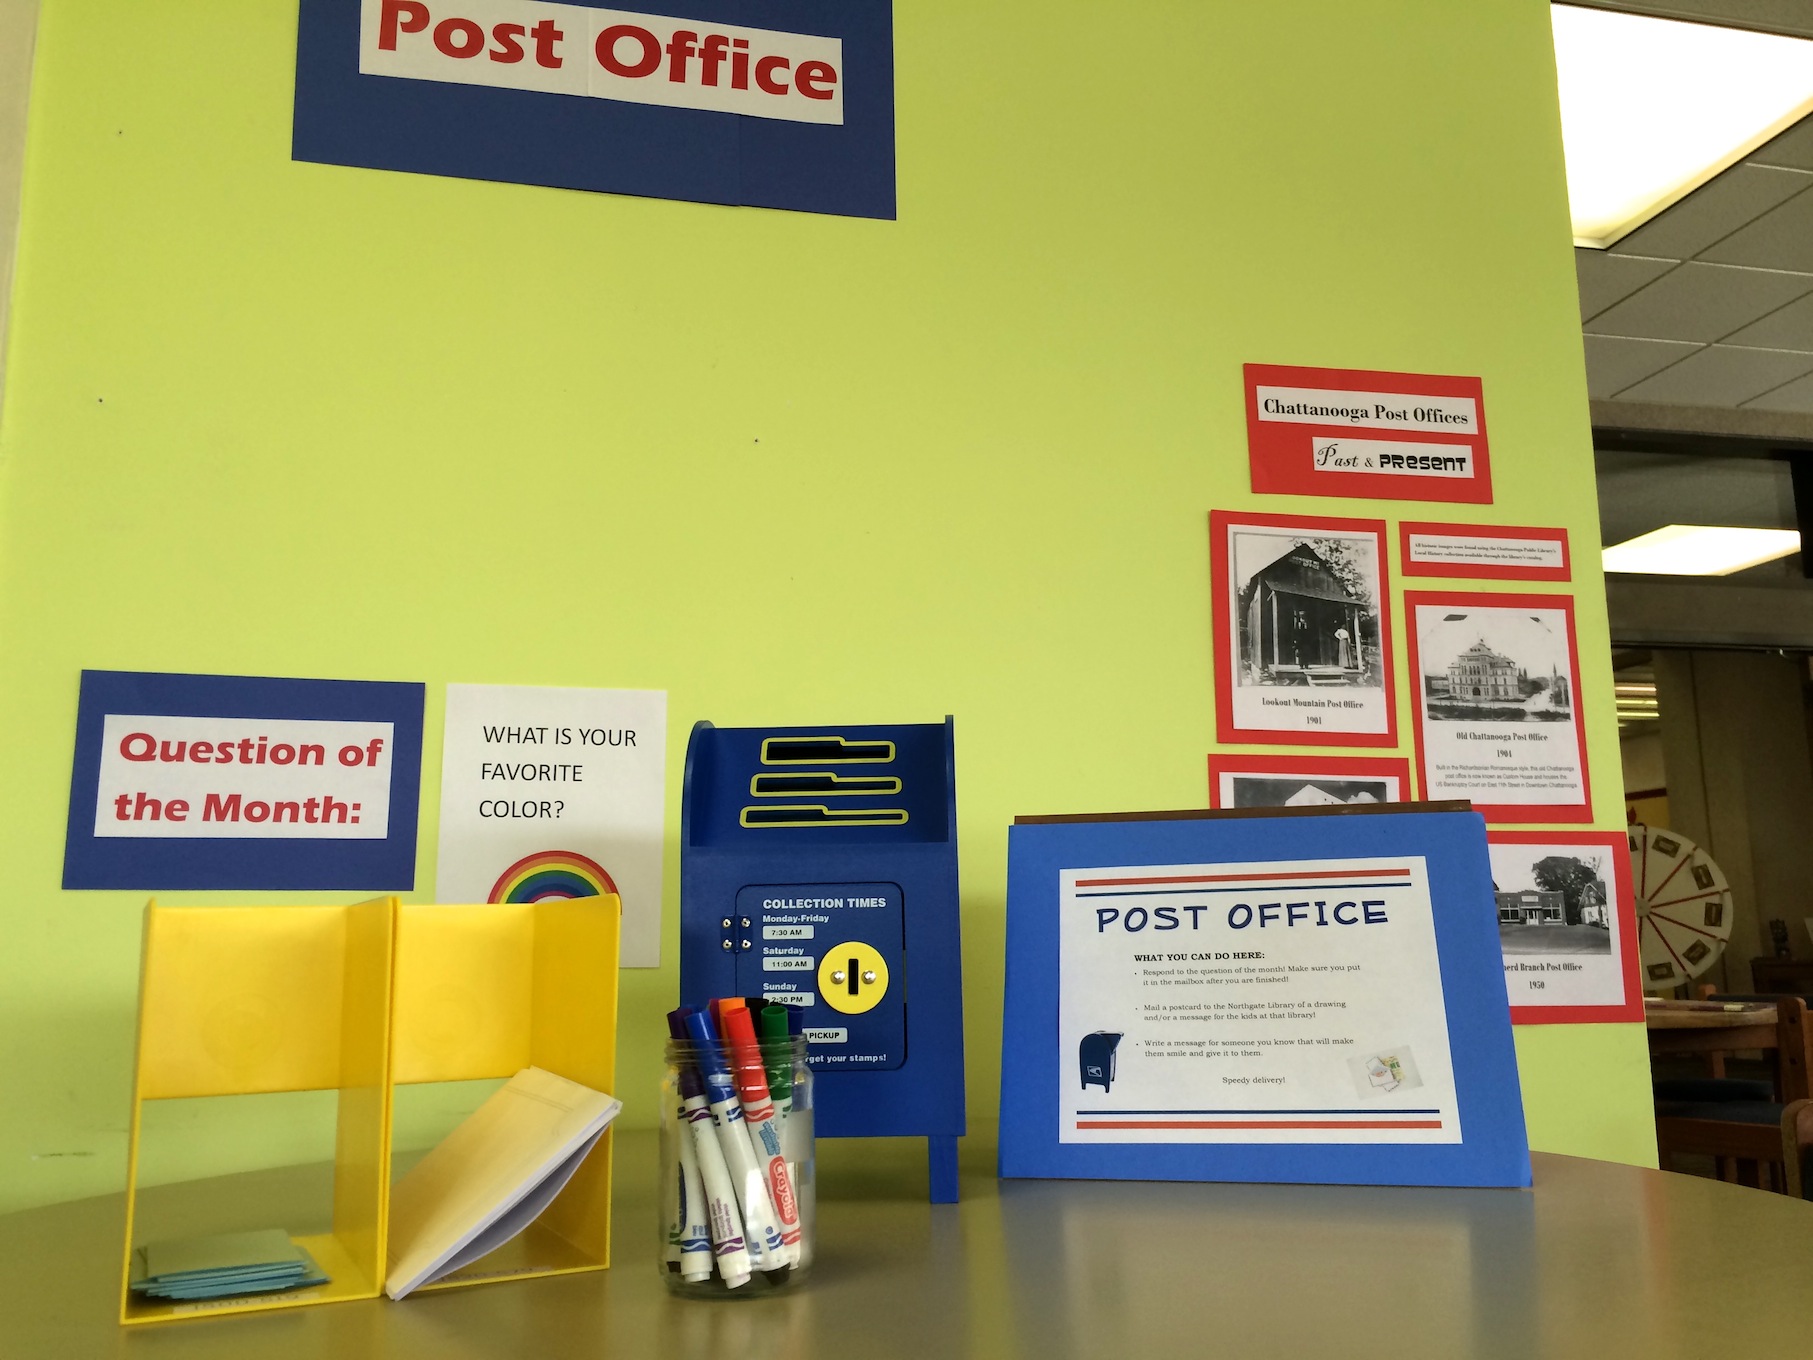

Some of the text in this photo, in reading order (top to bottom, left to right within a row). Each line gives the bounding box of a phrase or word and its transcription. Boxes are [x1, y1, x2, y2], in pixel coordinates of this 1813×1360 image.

[378, 0, 838, 100] Post Office
[1264, 398, 1469, 425] Chattanooga Post Offices
[1317, 443, 1359, 467] Past
[1365, 458, 1374, 468] &
[1262, 698, 1364, 708] Lookout Mountain Post Office
[1306, 716, 1322, 724] 1901
[483, 725, 637, 747] WHAT IS YOUR
[1469, 732, 1512, 742] Chattanooga
[1528, 733, 1548, 741] Office
[120, 732, 384, 767] Question of
[481, 763, 584, 782] FAVORITE
[114, 792, 361, 824] the Month:
[479, 800, 565, 819] COLOR?
[762, 898, 886, 909] COLLECTION TIMES
[762, 914, 830, 924] Monday-Friday
[1096, 900, 1389, 933] POST OFFICE
[771, 928, 803, 936] 7:30 AM
[763, 946, 805, 956] Saturday
[1232, 952, 1265, 960] HERE:
[1520, 963, 1544, 972] Branch
[1546, 963, 1561, 971] Post
[1562, 963, 1582, 971] Office
[763, 982, 798, 992] Sunday
[1530, 980, 1545, 990] 1950
[1169, 1004, 1202, 1012] postcard
[1228, 1002, 1266, 1010] Northgate
[1268, 1002, 1295, 1010] Library
[1287, 1012, 1316, 1020] library!
[849, 1054, 887, 1062] stamps!
[1222, 1076, 1286, 1084] Speedy delivery!
[774, 1161, 795, 1219] Crayola
